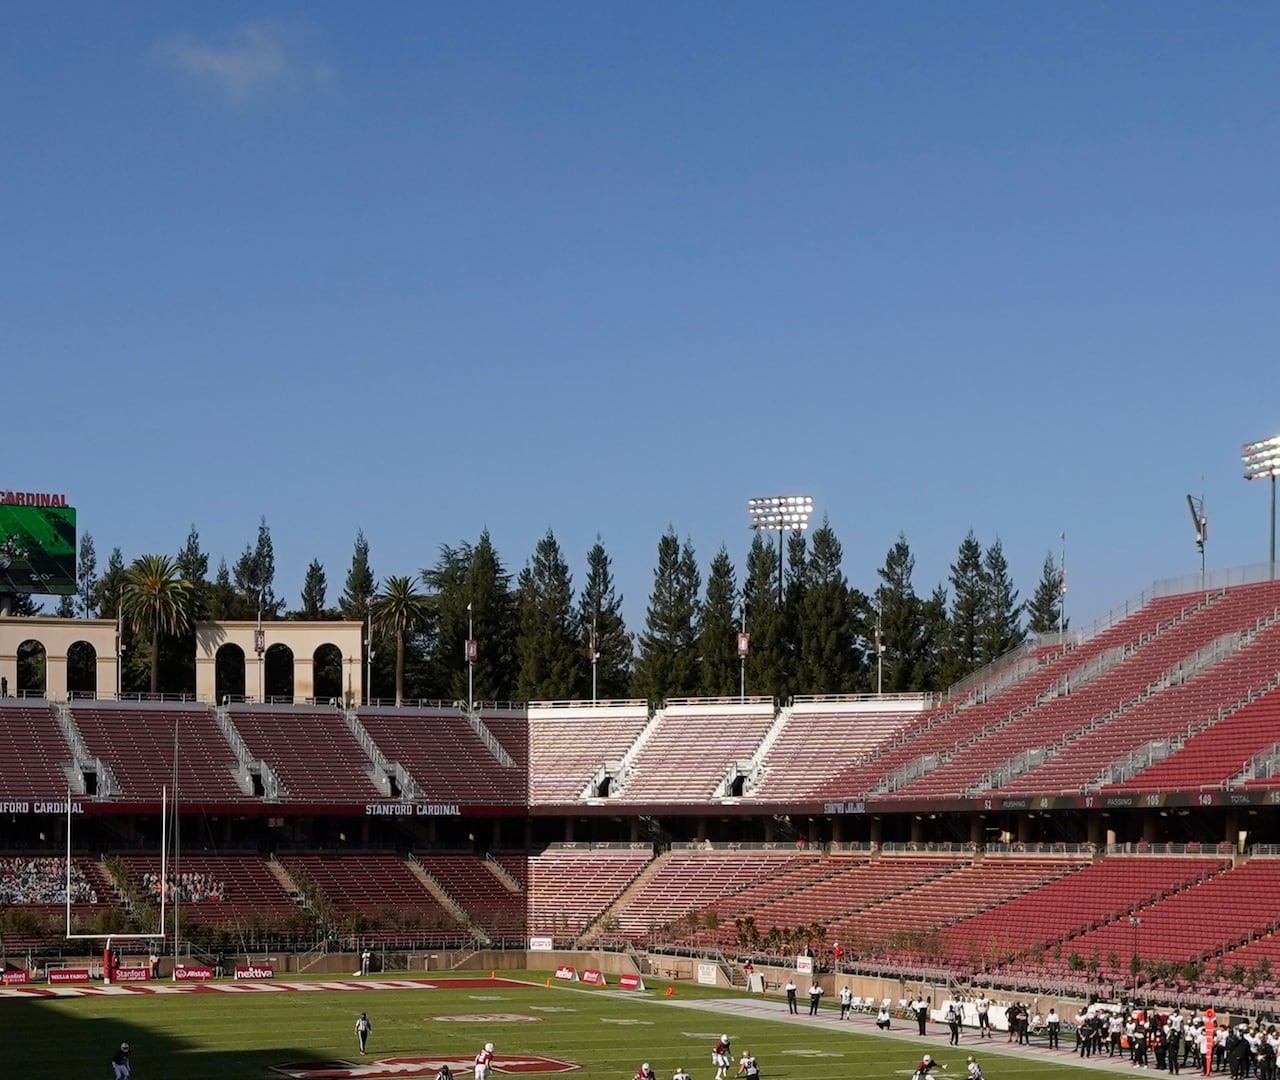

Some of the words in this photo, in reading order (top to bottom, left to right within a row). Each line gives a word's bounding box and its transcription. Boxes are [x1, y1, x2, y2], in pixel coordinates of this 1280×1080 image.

[984, 801, 992, 810] 52
[1003, 800, 1026, 808] RUSHING
[1085, 797, 1094, 807] 97
[1146, 795, 1160, 806] 105
[1198, 795, 1212, 805] 149
[365, 805, 413, 815] STANFORD
[416, 805, 461, 815] CARDINAL
[238, 967, 273, 978] nextiva
